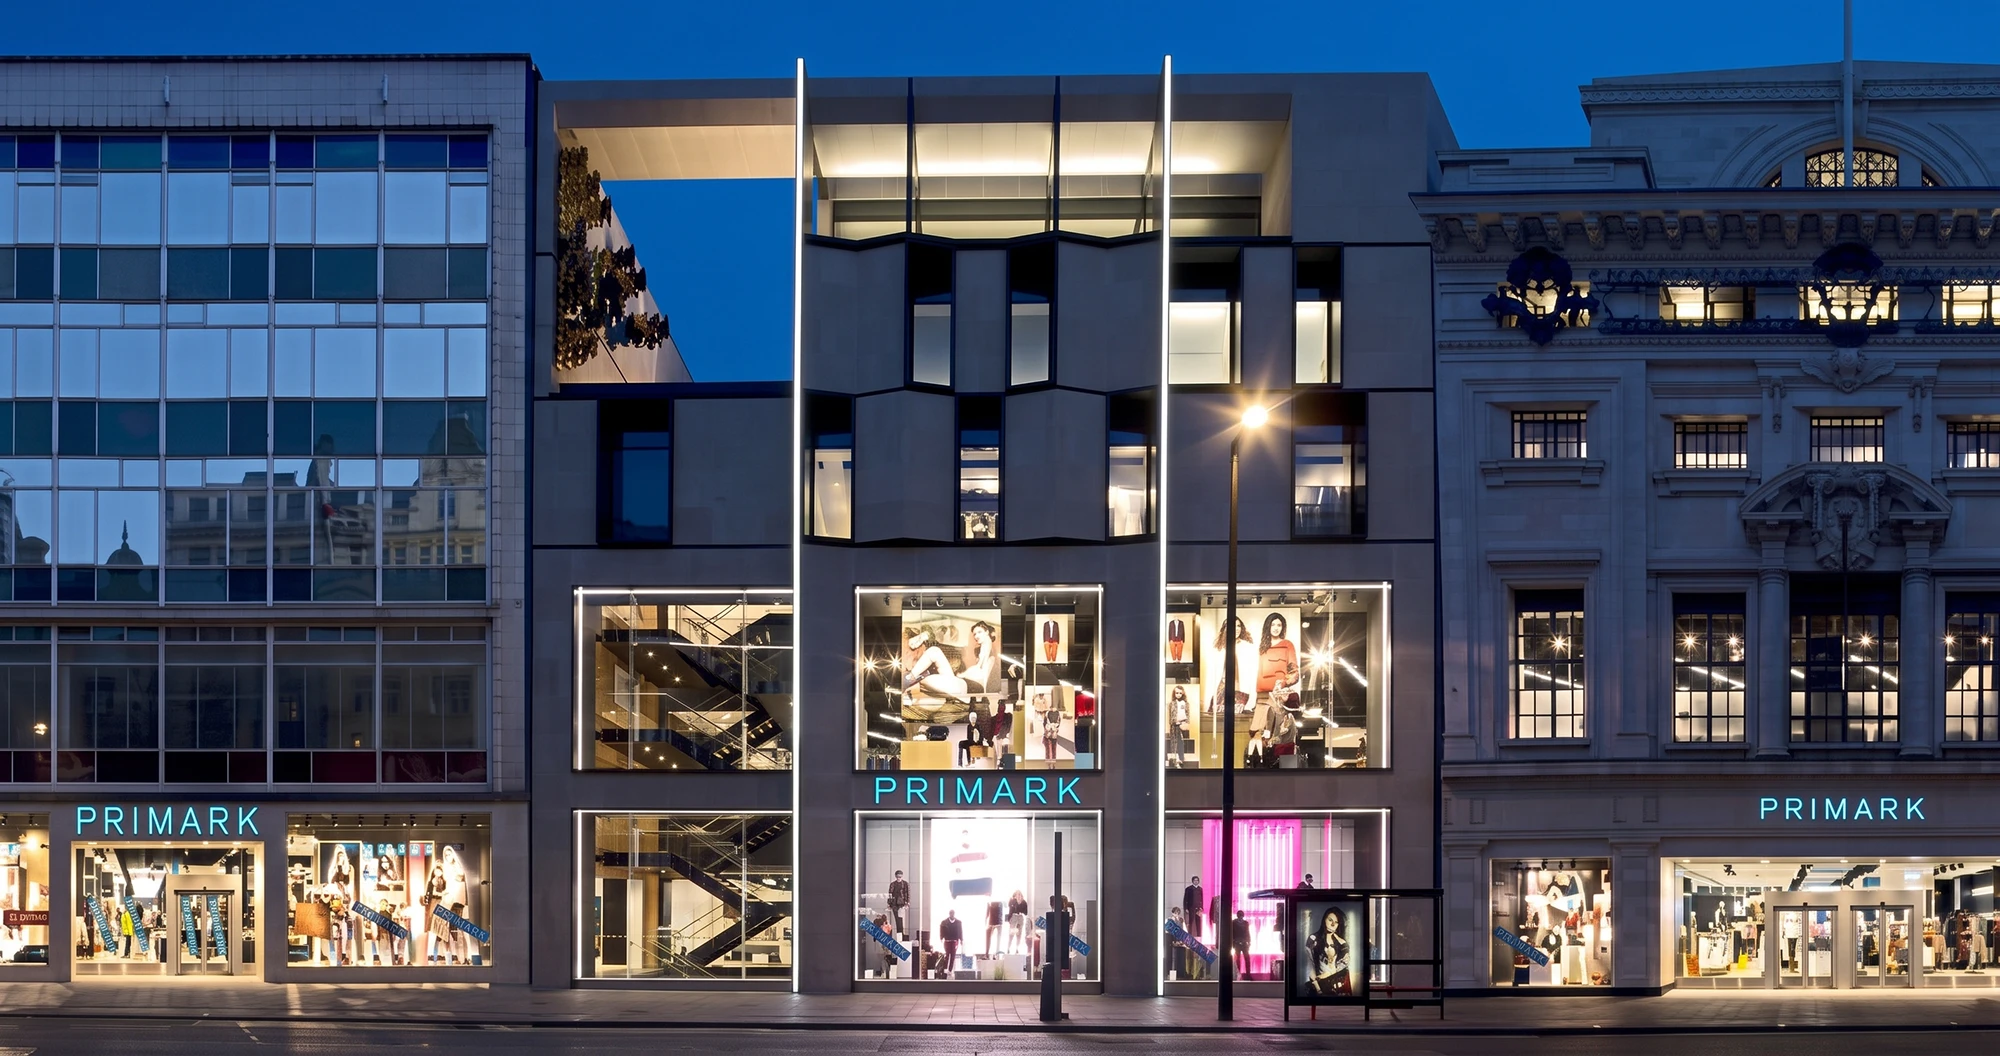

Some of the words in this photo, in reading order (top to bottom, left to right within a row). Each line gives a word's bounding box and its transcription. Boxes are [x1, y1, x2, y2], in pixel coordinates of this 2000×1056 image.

[875, 776, 1081, 804] PRIMARK
[76, 806, 259, 836] PRIMARK
[1760, 797, 1925, 820] PRIMARK
